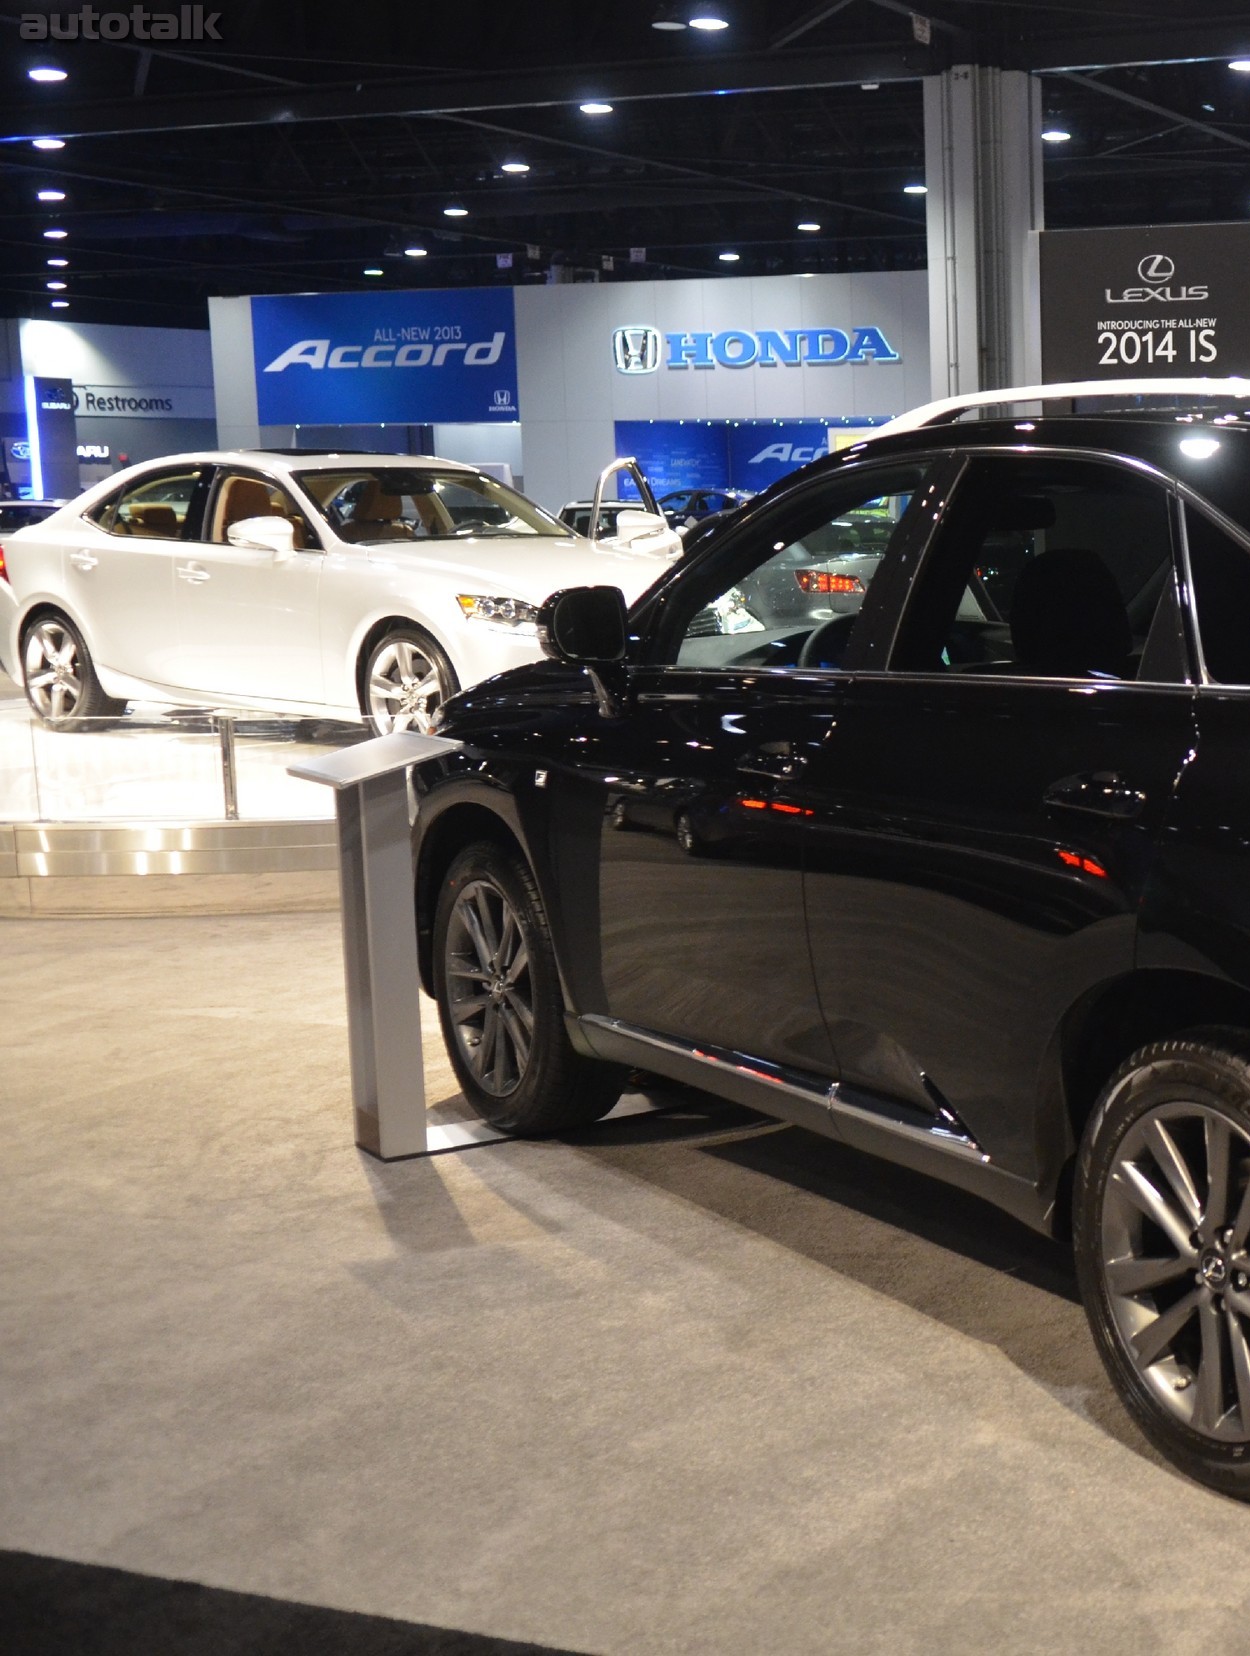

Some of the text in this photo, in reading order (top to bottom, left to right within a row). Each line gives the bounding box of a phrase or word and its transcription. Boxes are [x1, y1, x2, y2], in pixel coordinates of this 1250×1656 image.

[1105, 285, 1209, 303] LEXUS
[374, 326, 462, 341] ALL-NEW 2013
[1097, 318, 1217, 331] INTRODUCING THE ALL-NEW
[262, 332, 506, 373] Accord
[664, 326, 900, 368] HONDA
[1097, 328, 1218, 365] 2014 IS
[86, 392, 173, 412] Restrooms
[76, 445, 110, 458] ARU
[748, 442, 829, 464] Acc
